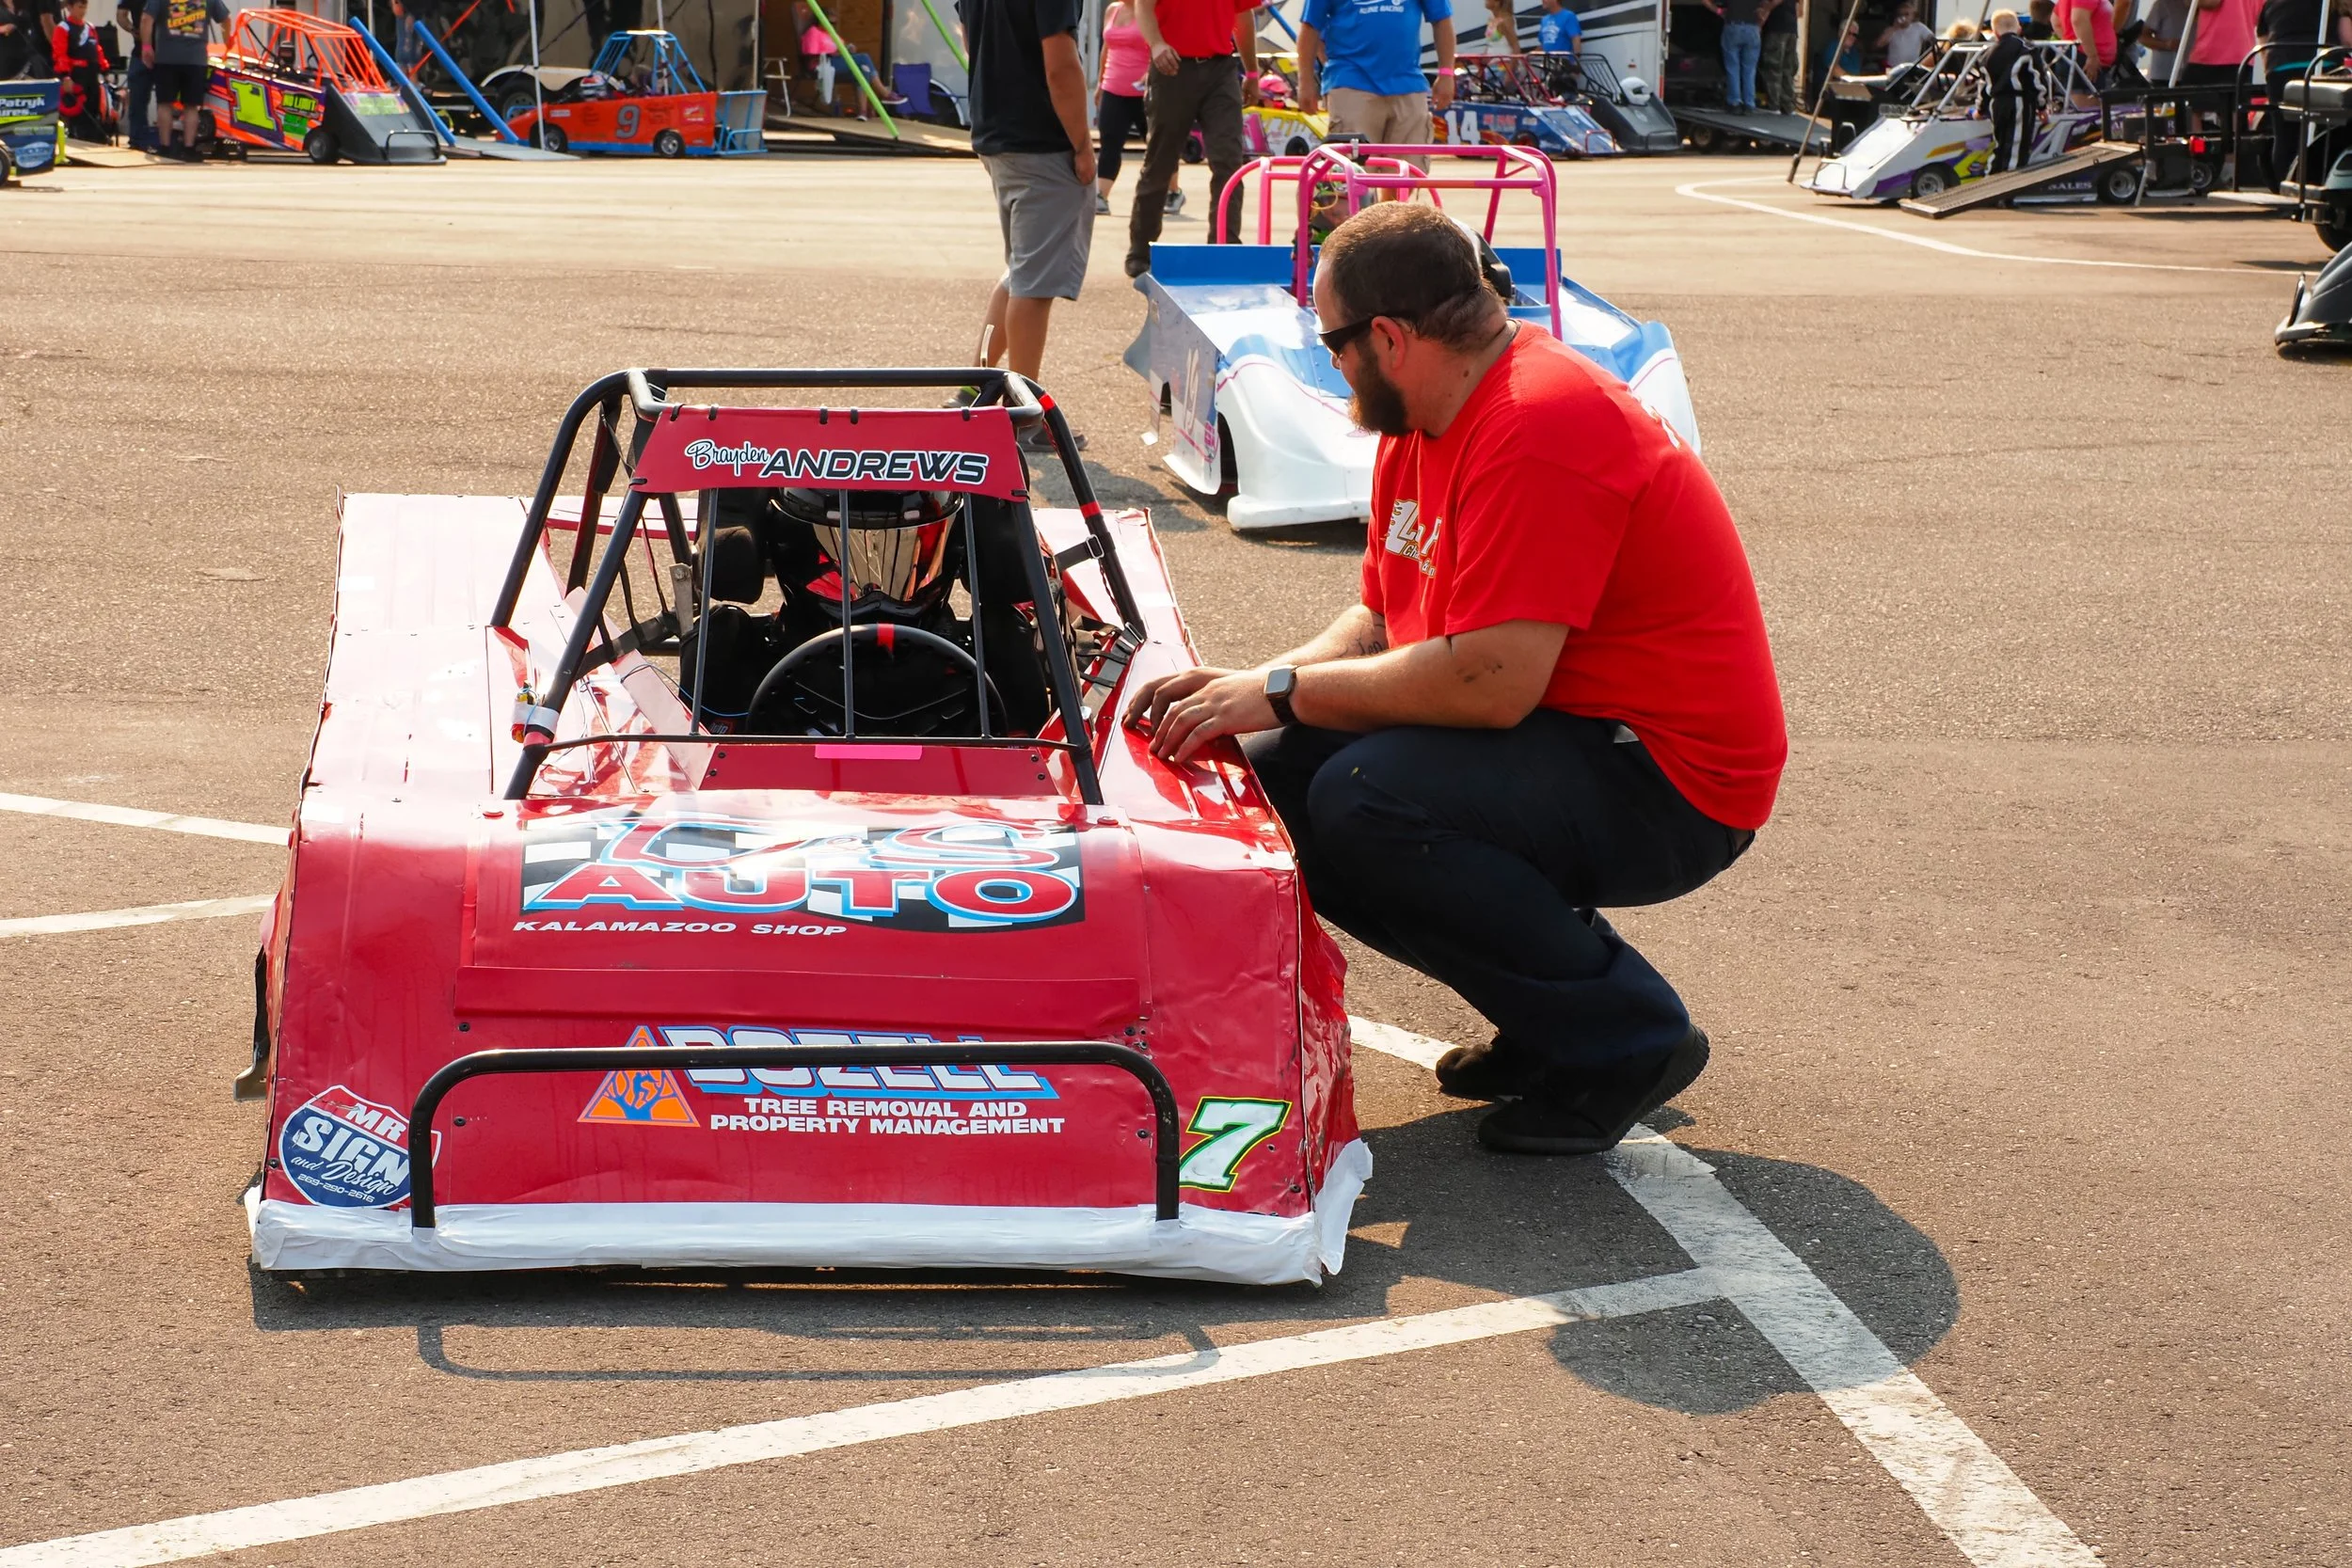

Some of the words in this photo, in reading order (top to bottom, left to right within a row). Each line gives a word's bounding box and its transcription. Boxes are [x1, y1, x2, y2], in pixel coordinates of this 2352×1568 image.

[0, 97, 45, 108] Patryk
[615, 103, 641, 139] 9
[1444, 109, 1482, 145] 14
[685, 438, 771, 476] Brayden
[758, 449, 989, 484] ANDREWS
[523, 862, 1078, 924] AUTO
[513, 921, 738, 933] KALAMAZOO
[750, 923, 848, 936] SHOP
[710, 1115, 860, 1133] PROPERTY
[869, 1117, 1065, 1135] MANAGEMENT
[744, 1097, 818, 1116] TREE
[827, 1100, 960, 1117] REMOVAL
[968, 1101, 1027, 1117] AND
[292, 1116, 410, 1187] SIGN
[1179, 1097, 1293, 1193] 7
[290, 1156, 324, 1172] and
[320, 1161, 399, 1196] Design
